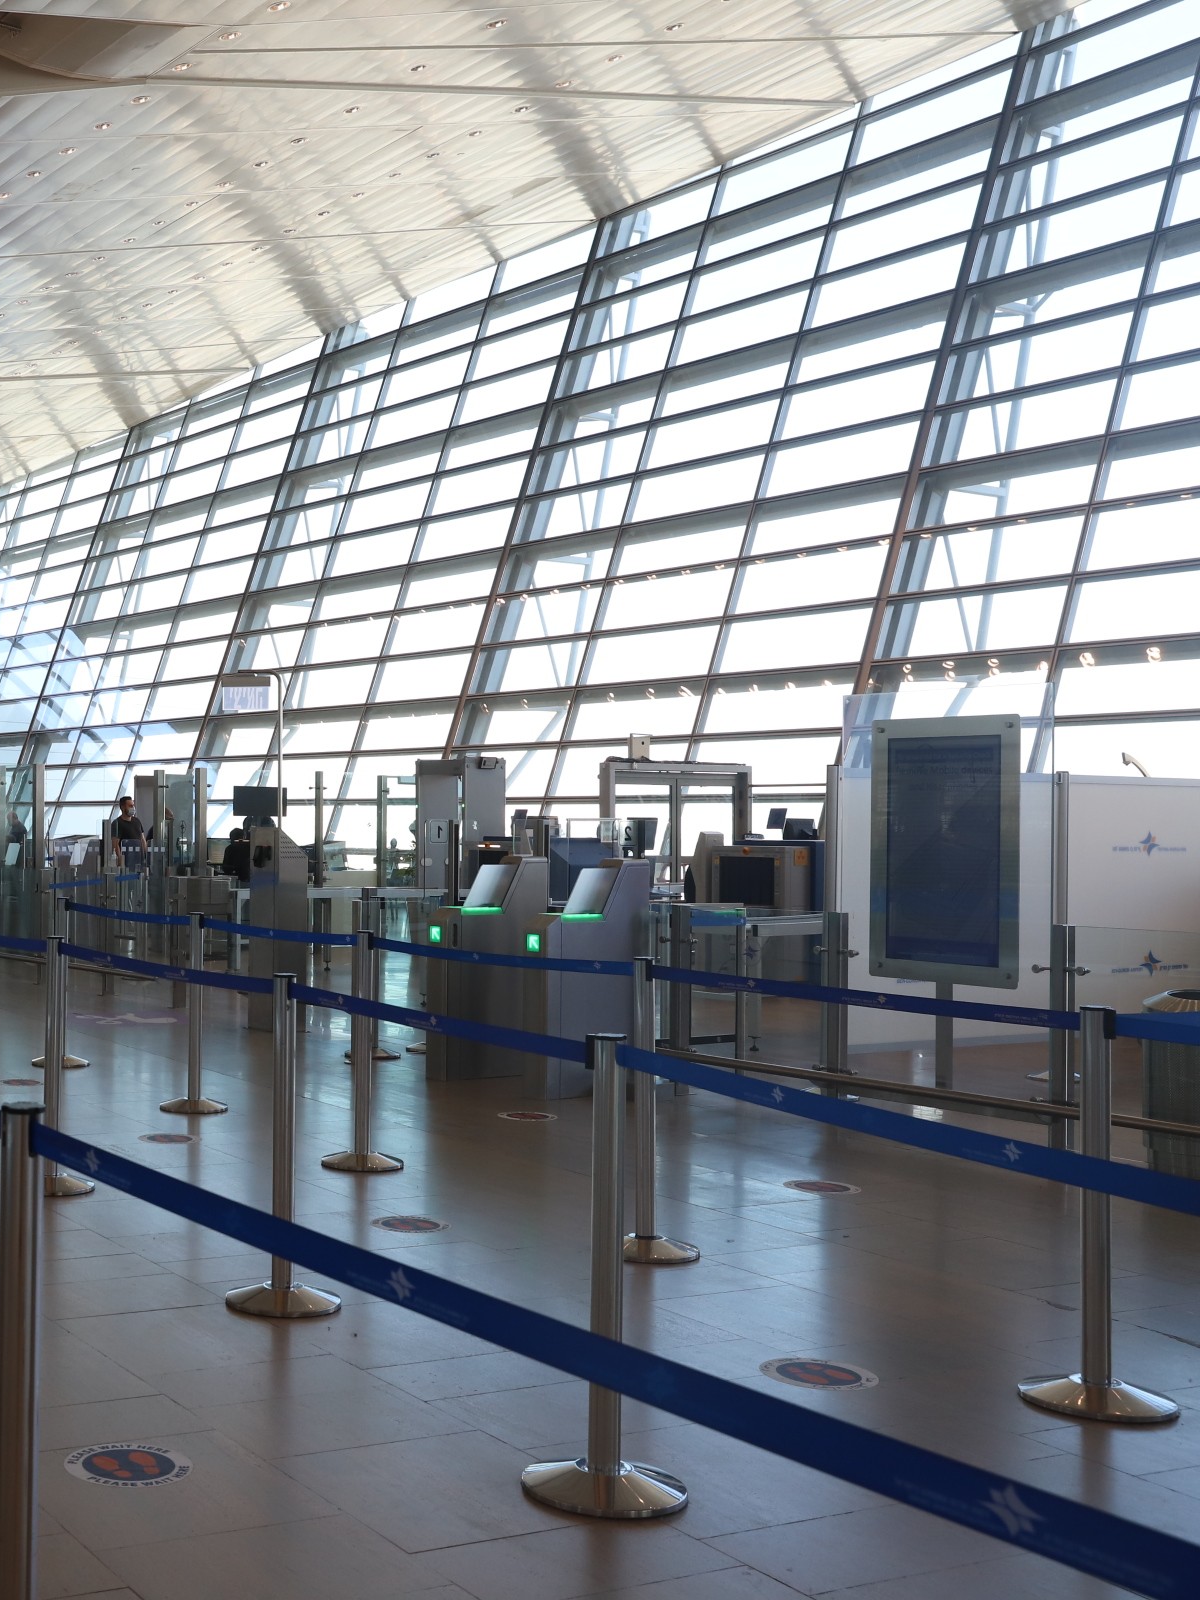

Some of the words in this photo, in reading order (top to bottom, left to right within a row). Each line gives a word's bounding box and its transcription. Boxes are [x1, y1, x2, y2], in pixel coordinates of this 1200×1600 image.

[67, 1447, 96, 1465] PLEASE
[137, 1444, 171, 1454] HERE
[87, 1476, 138, 1487] PLEASE
[141, 1477, 173, 1487] WAIT
[173, 1465, 190, 1479] HERE
